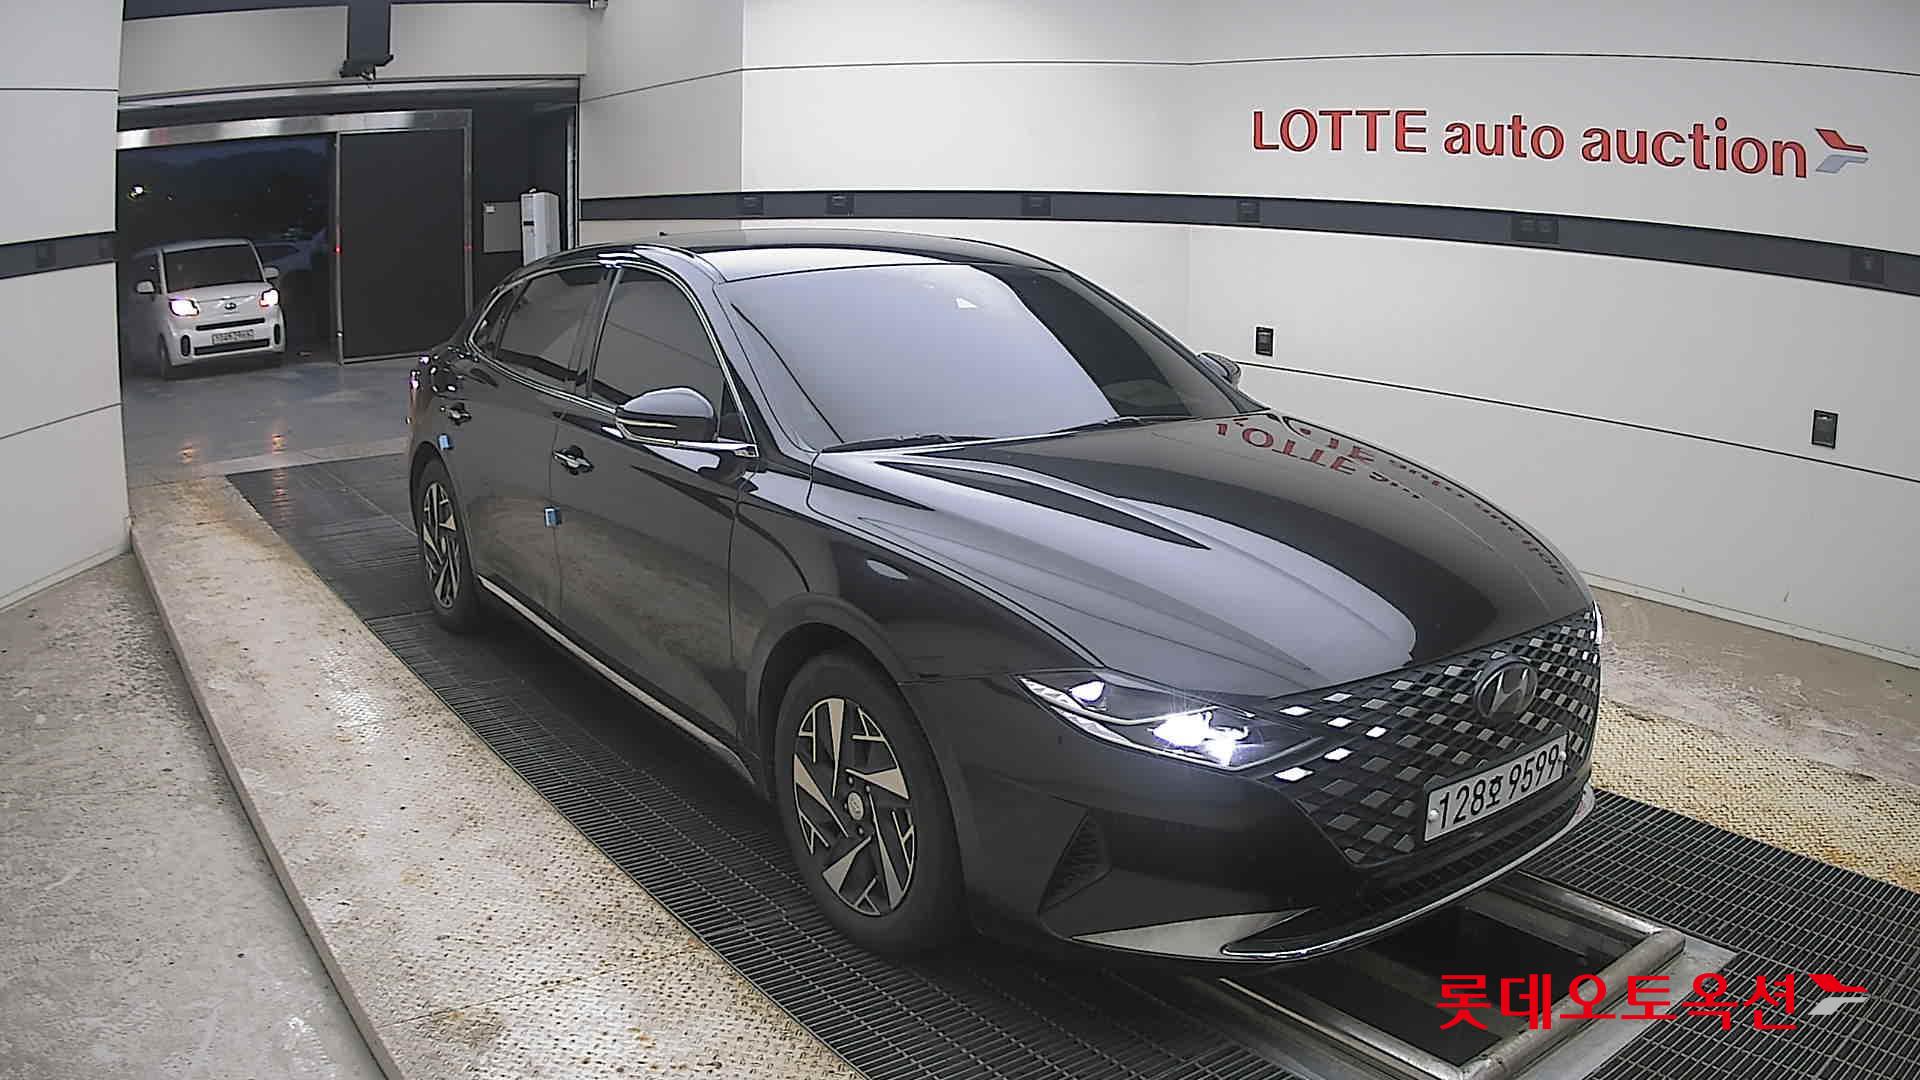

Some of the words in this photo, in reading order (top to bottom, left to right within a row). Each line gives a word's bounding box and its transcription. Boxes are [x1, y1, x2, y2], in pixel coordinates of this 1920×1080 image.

[1252, 109, 1428, 153] LOTTE
[1443, 114, 1566, 161] auto
[1581, 118, 1808, 179] auction
[1508, 743, 1560, 800] 9599
